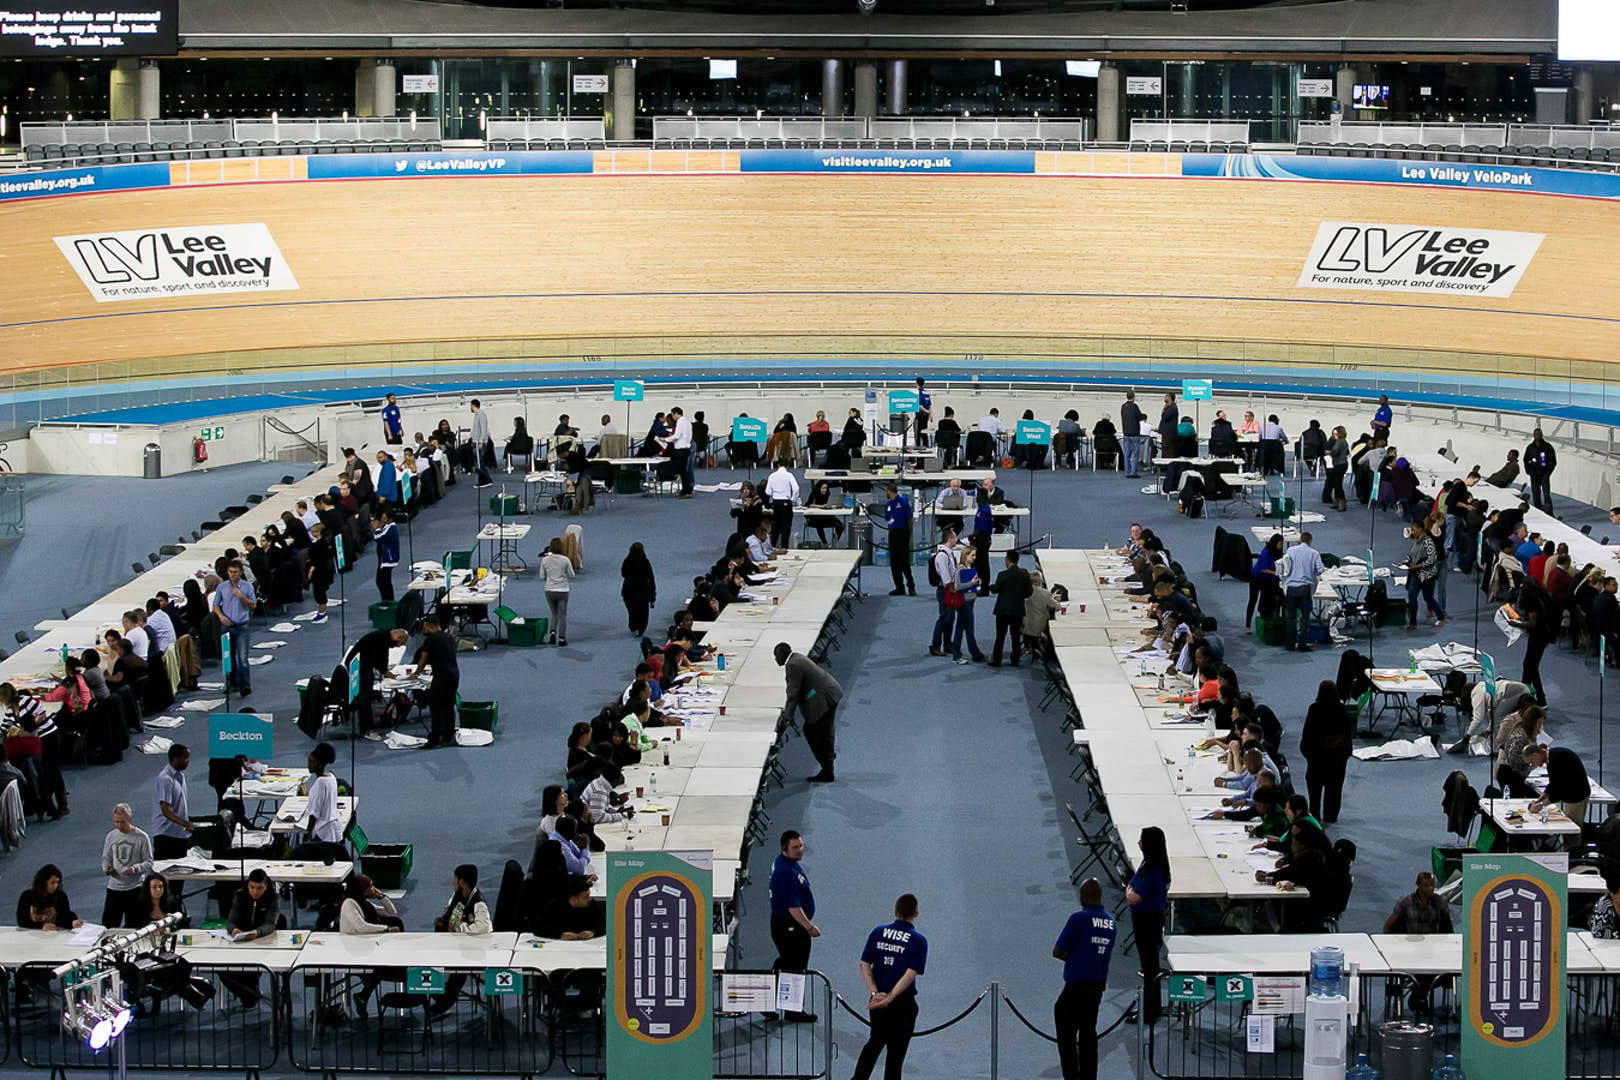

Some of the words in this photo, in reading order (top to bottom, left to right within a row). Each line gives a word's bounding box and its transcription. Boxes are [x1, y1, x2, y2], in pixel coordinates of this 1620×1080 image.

[95, 11, 115, 22] and
[117, 11, 161, 24] personal
[86, 23, 111, 34] from
[112, 24, 130, 34] the
[68, 35, 101, 46] Thank
[416, 159, 506, 172] @LeeValleyVP
[822, 157, 952, 169] visitleevalley.org.uk
[1402, 166, 1426, 179] Lee
[1429, 167, 1470, 183] Valley
[1473, 170, 1533, 185] VeloPark
[160, 233, 227, 255] Lee
[1421, 231, 1490, 255] Lee
[171, 253, 272, 278] Valley
[1414, 253, 1517, 284] Valley
[101, 287, 120, 297] For
[122, 285, 160, 295] nature,
[162, 282, 191, 293] sport
[193, 279, 217, 290] and
[217, 277, 271, 289] discovery
[1311, 273, 1332, 283] For
[1332, 275, 1374, 286] nature,
[1376, 277, 1409, 288] sport
[1410, 278, 1434, 288] and
[1435, 280, 1490, 293] discovery
[219, 731, 263, 741] Beckton
[628, 860, 645, 869] Map
[1470, 863, 1483, 871] Site
[1484, 863, 1501, 873] Map
[1092, 917, 1114, 930] WISE
[882, 928, 911, 943] WISE
[876, 941, 906, 954] SECURITY
